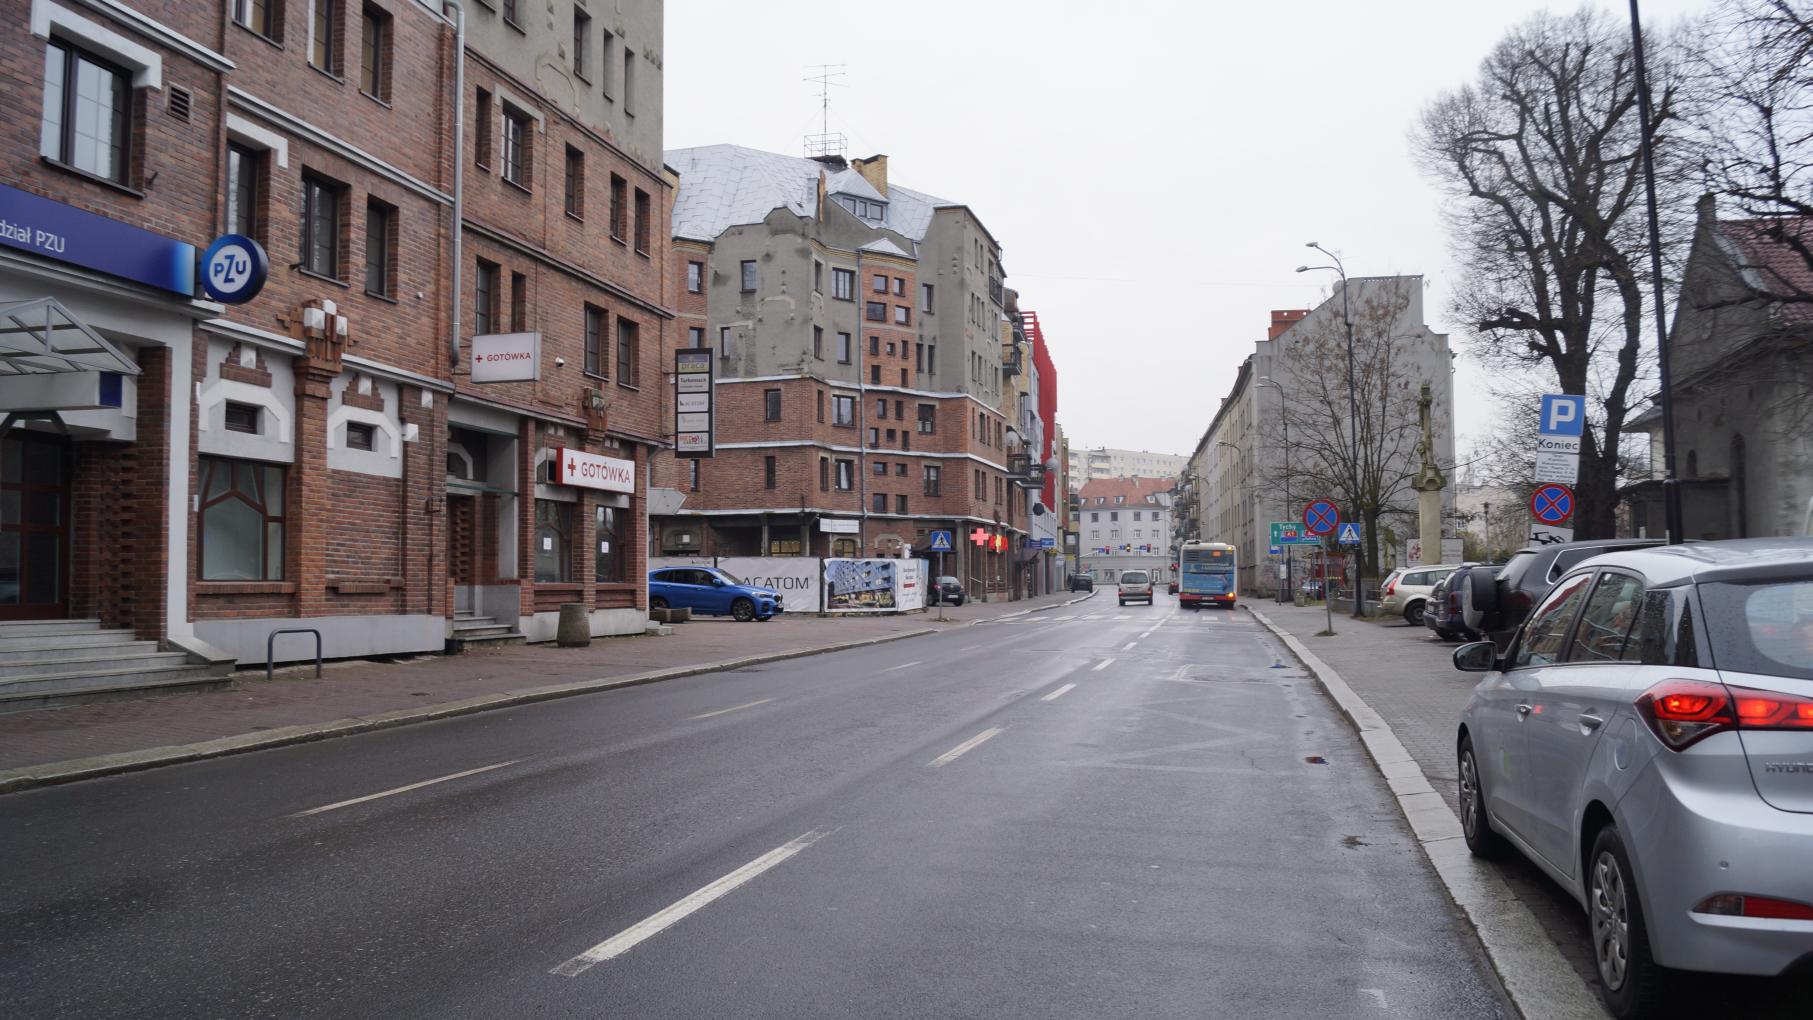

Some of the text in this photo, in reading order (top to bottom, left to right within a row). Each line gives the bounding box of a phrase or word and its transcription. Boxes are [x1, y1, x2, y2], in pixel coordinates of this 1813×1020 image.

[36, 230, 65, 253] PZU
[214, 254, 247, 284] PZU
[486, 352, 531, 362] GOTÓWKA
[1549, 399, 1576, 430] P
[1538, 439, 1578, 450] Koniec
[581, 461, 631, 483] GOTÓWKA
